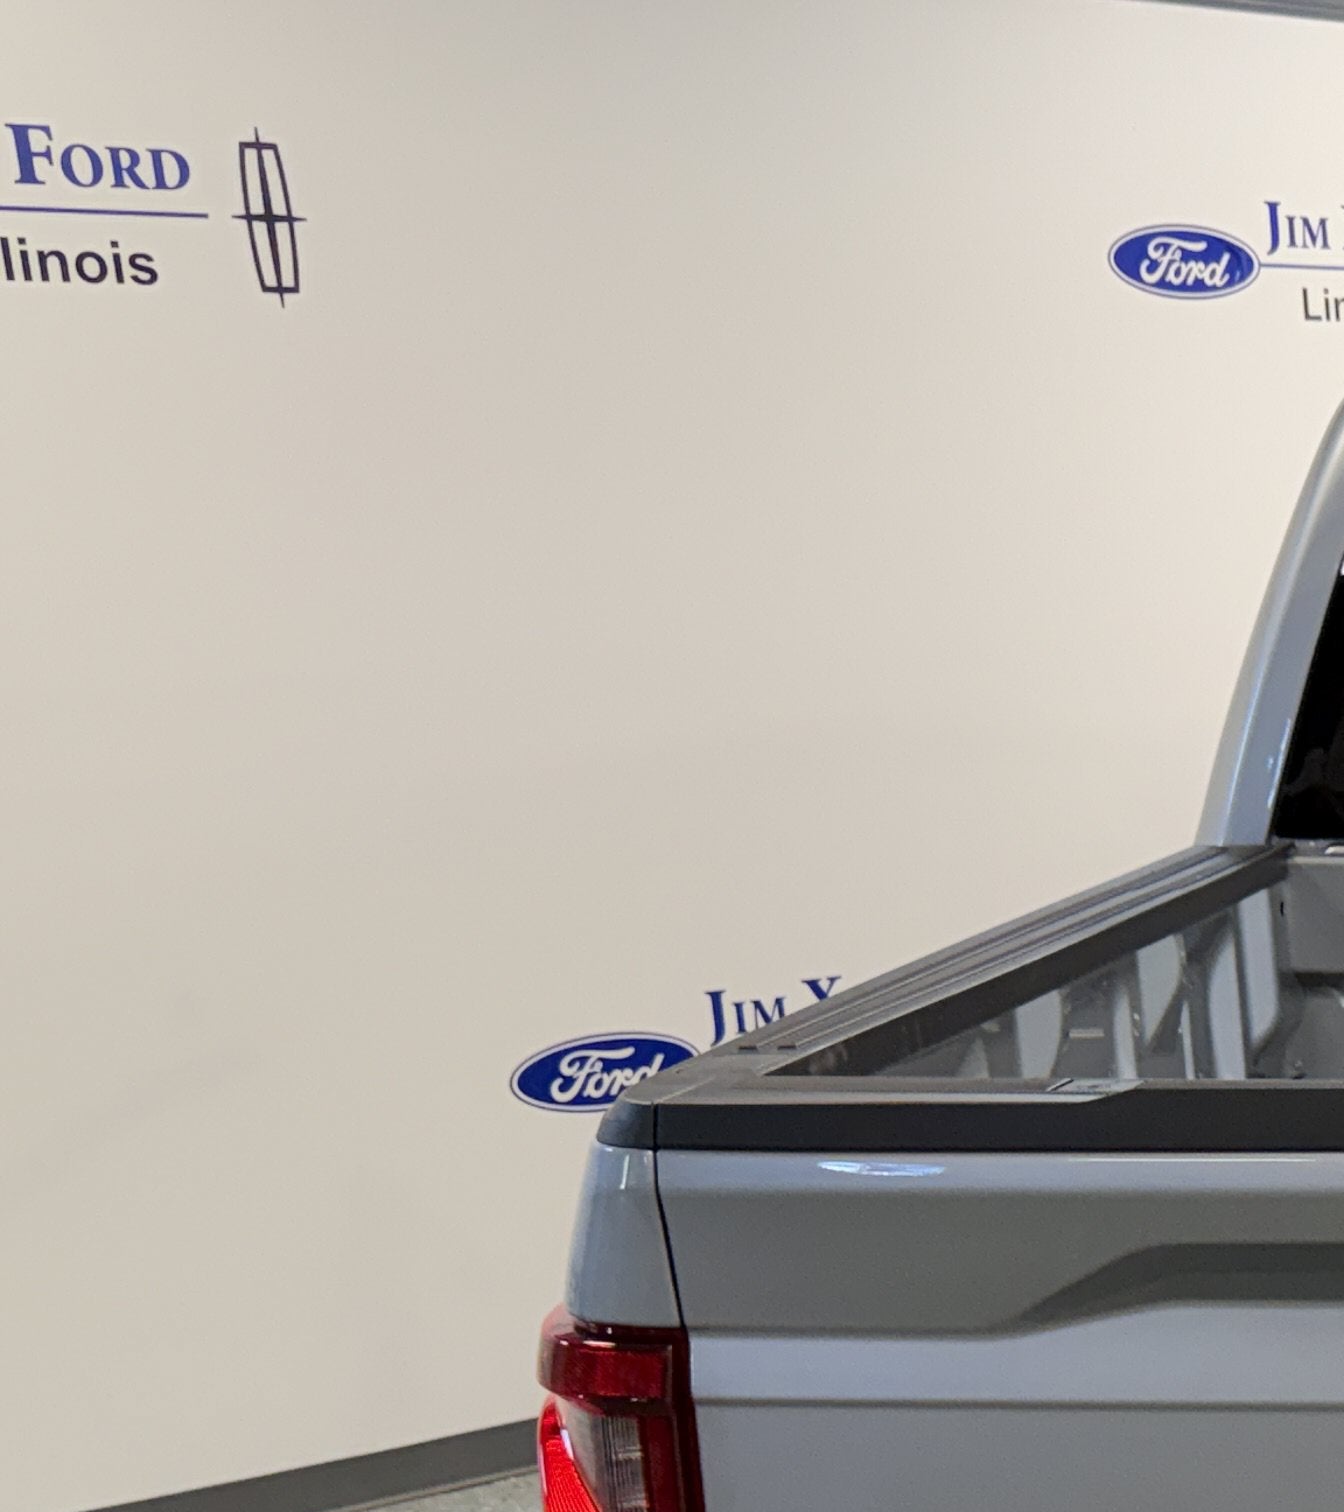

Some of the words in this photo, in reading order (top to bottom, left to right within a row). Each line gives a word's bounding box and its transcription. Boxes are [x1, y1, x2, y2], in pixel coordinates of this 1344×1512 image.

[4, 123, 190, 190] FORD
[1264, 201, 1329, 255] JIM
[1140, 236, 1230, 288] Ford
[704, 989, 786, 1047] JIM
